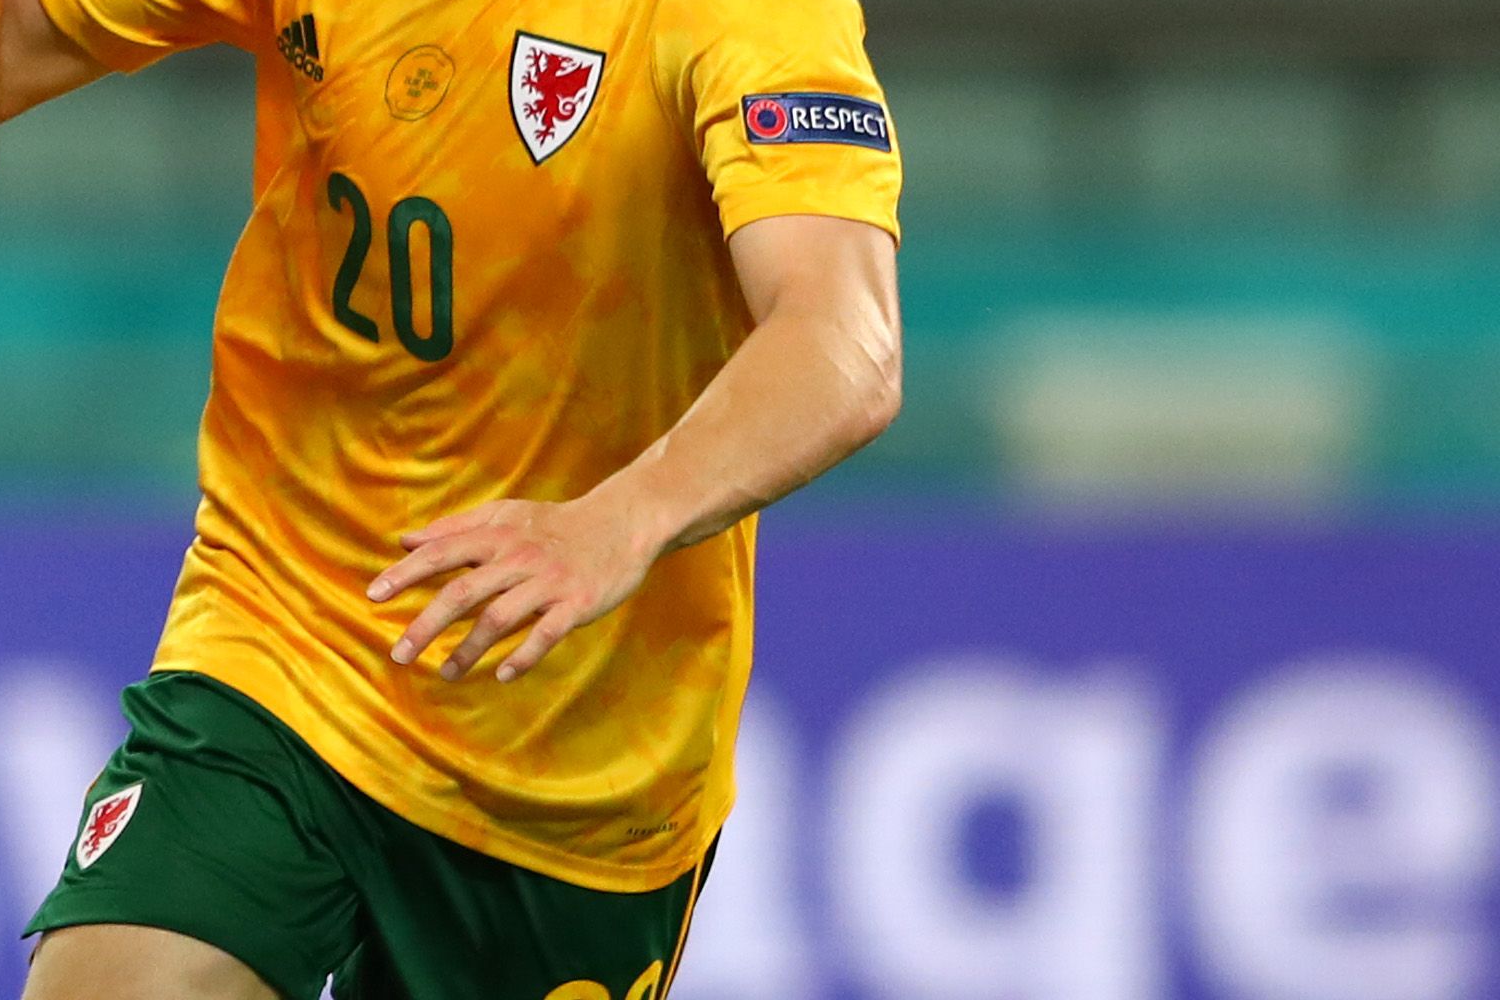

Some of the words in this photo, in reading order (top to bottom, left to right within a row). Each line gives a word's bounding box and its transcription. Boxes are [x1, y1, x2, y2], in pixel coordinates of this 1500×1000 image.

[276, 36, 324, 82] adidas
[791, 106, 886, 138] RESPECT
[327, 172, 453, 362] 20
